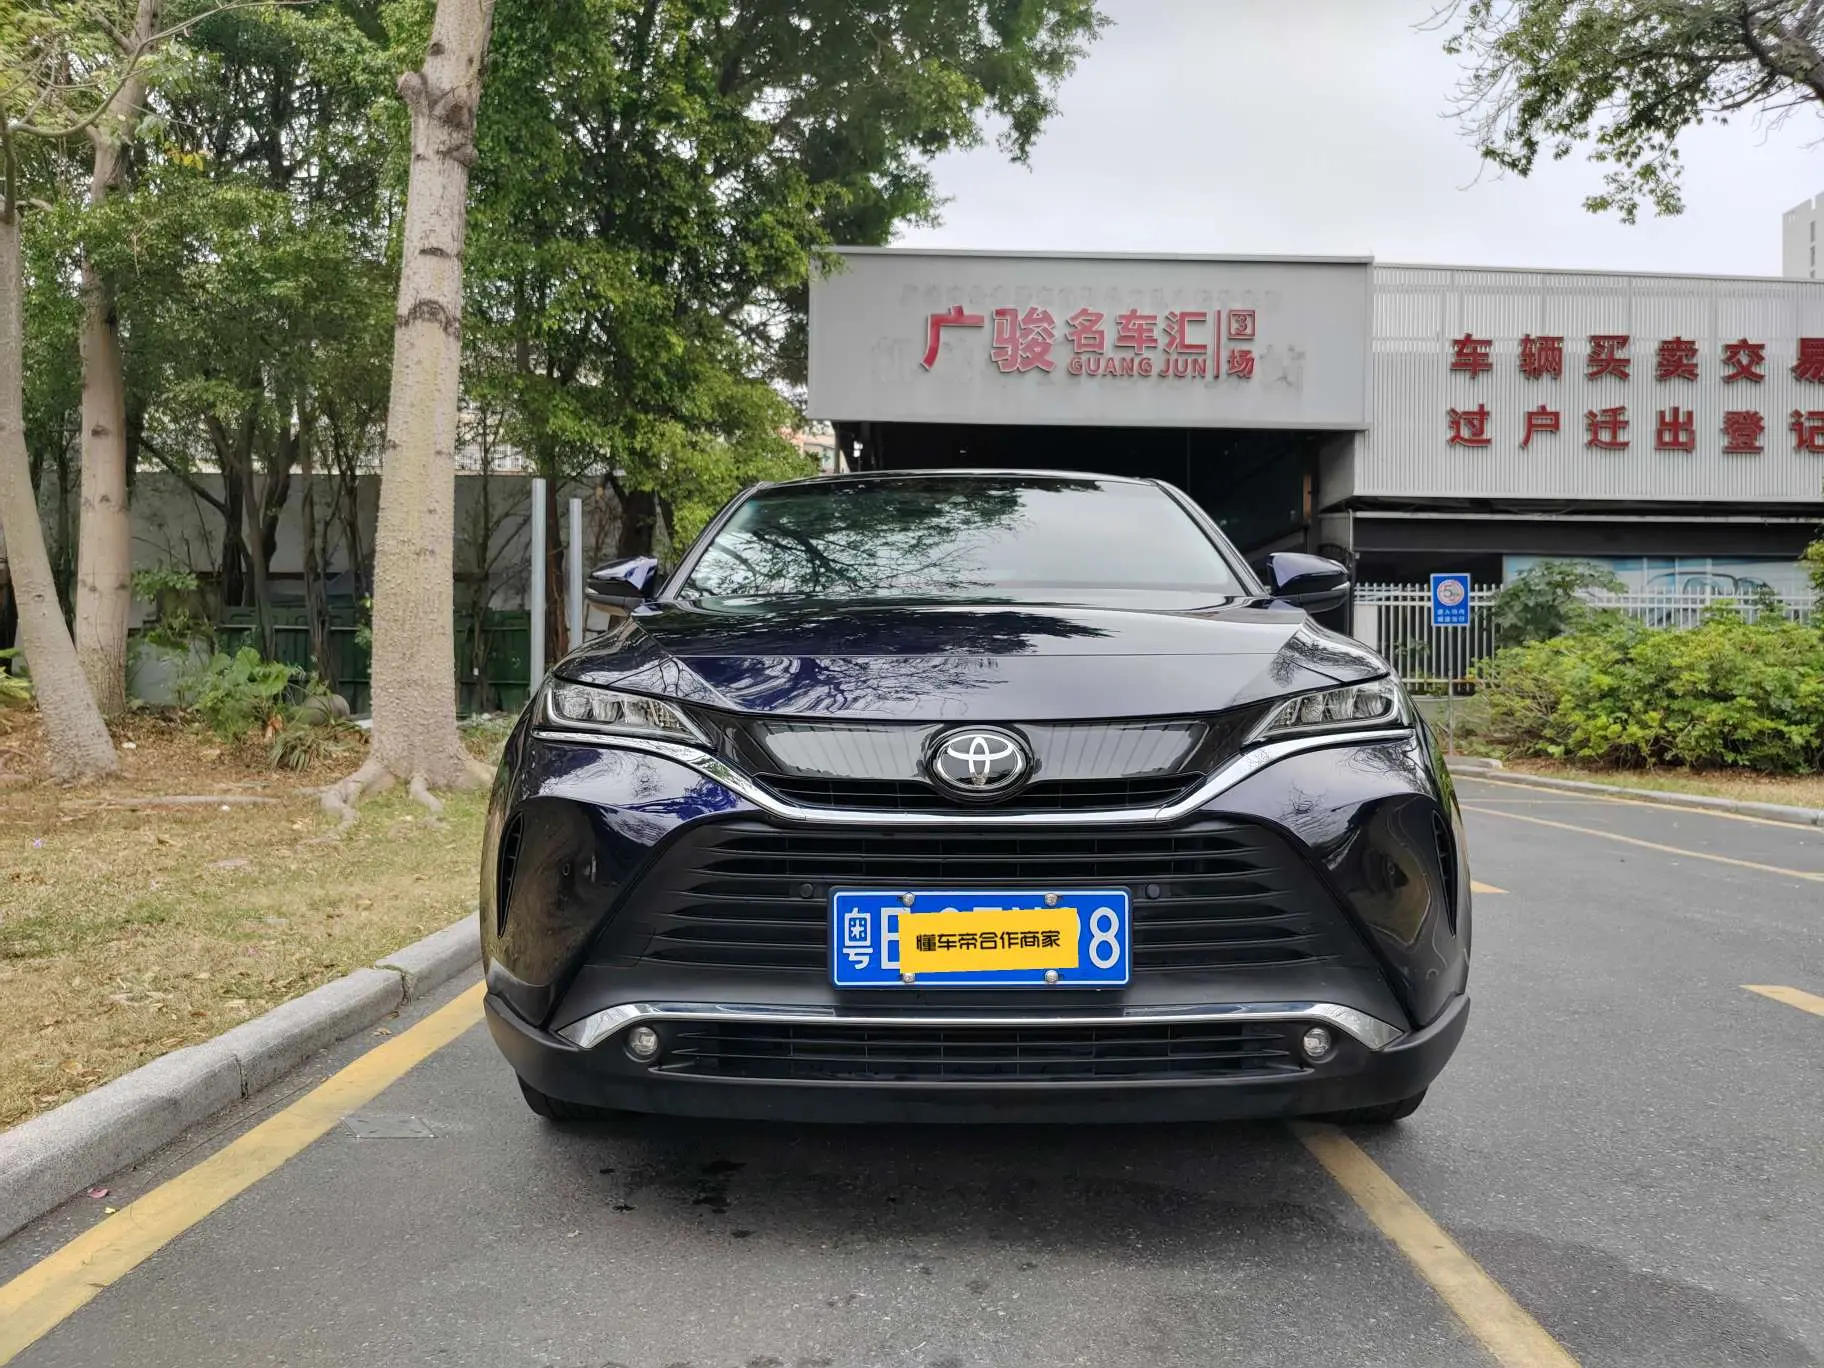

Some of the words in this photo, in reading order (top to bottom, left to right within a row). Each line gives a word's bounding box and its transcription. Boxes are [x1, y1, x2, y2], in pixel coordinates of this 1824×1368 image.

[920, 304, 1207, 372] 广骏名车汇
[1450, 333, 1824, 383] 车辆买卖交易
[1068, 356, 1152, 376] GUANG
[1159, 357, 1207, 377] JUN
[1447, 404, 1824, 453] 过户迁出登记
